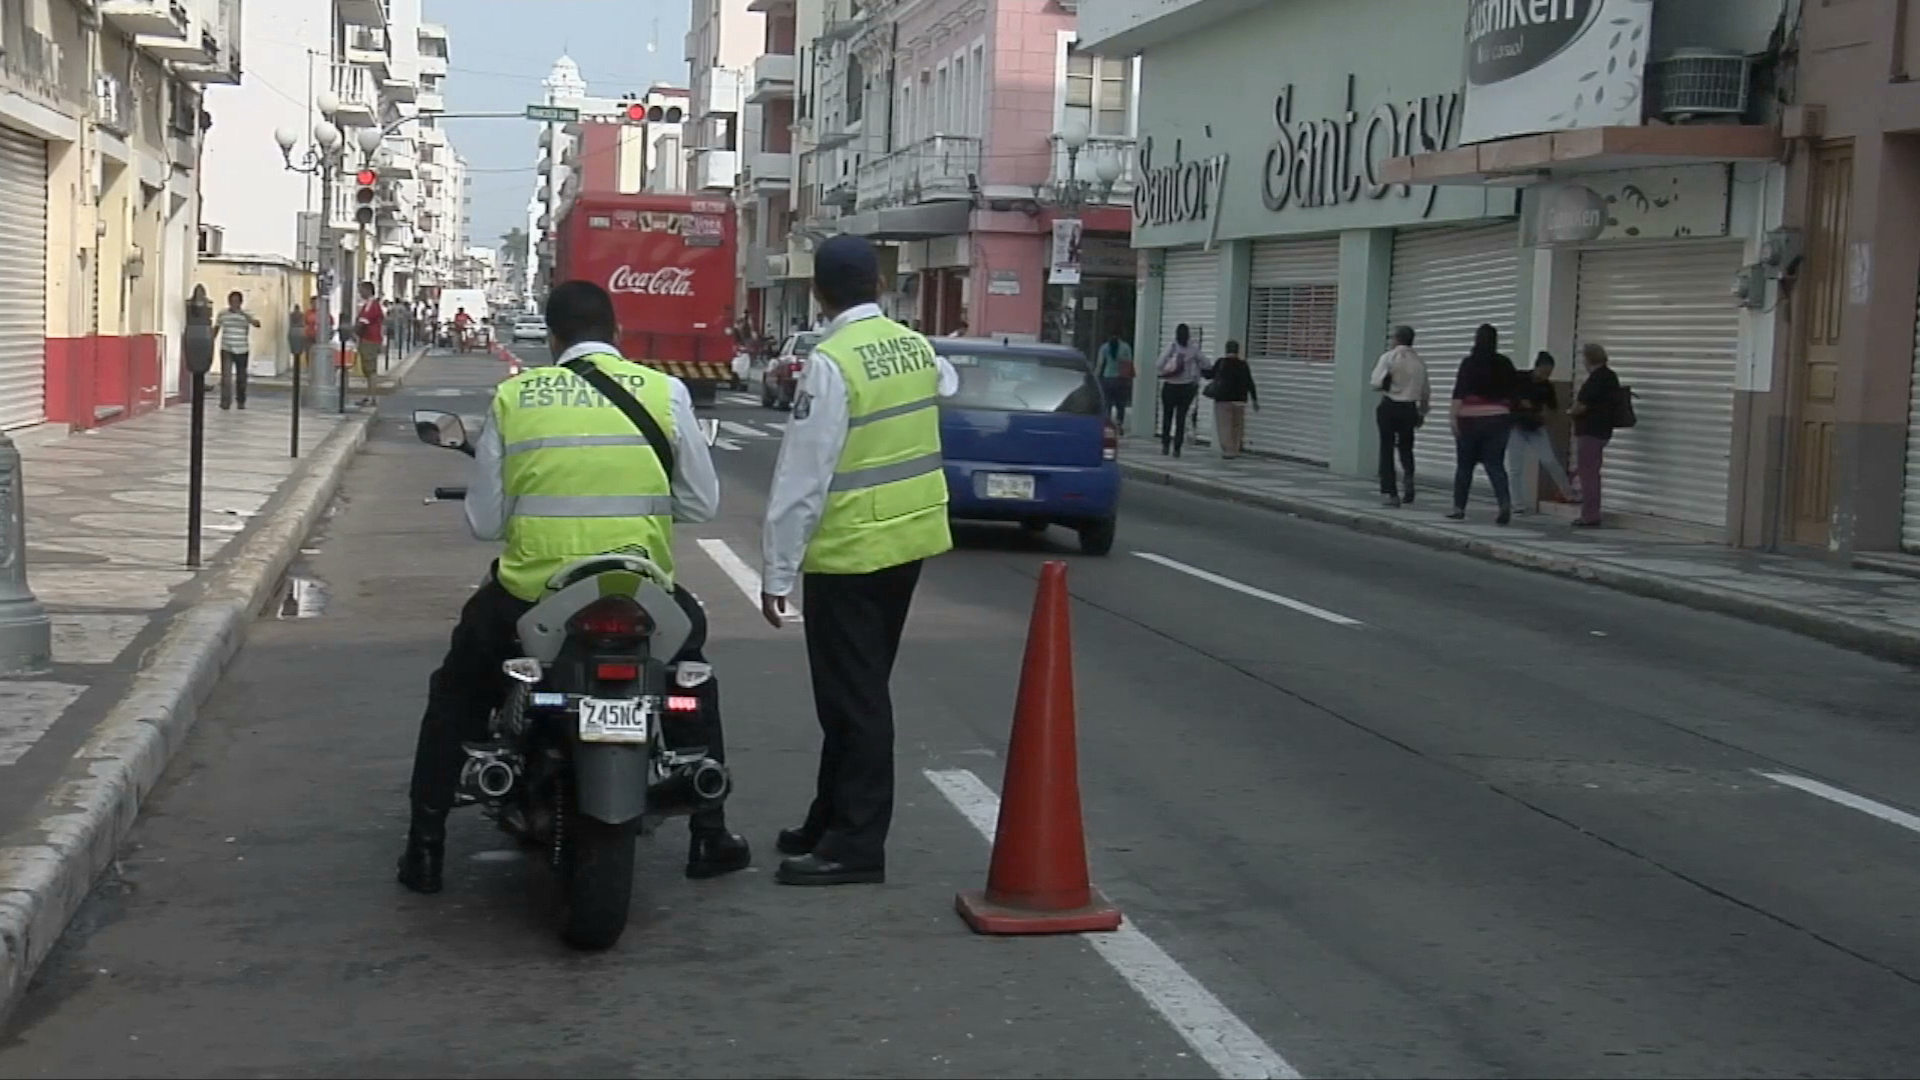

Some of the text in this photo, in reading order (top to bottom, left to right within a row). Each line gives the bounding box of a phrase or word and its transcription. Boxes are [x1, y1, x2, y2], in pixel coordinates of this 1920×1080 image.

[1134, 134, 1230, 251] Santory
[1262, 73, 1459, 218] Santory
[586, 705, 642, 726] Z45NC
